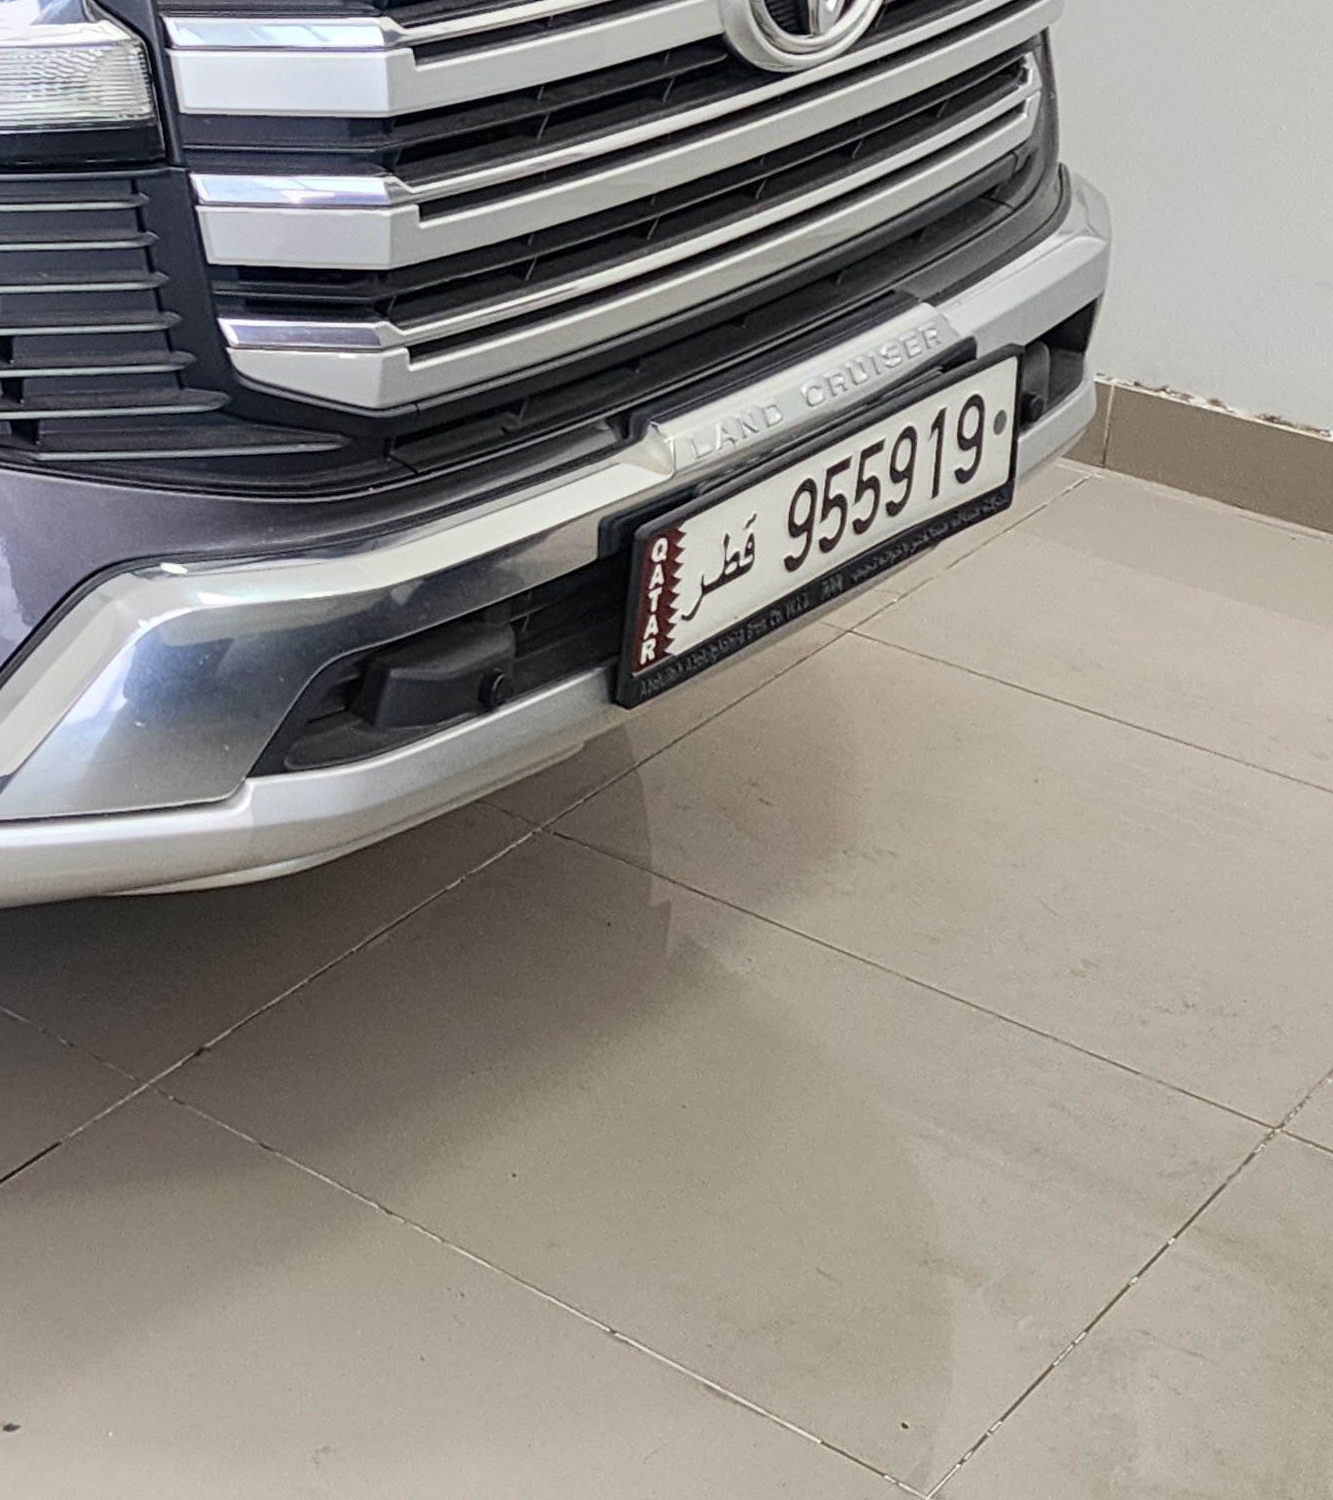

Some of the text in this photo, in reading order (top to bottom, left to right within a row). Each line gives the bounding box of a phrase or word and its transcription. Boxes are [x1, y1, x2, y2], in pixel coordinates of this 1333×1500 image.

[688, 323, 943, 460] LAND CRUISER
[784, 393, 987, 573] 955919
[640, 537, 669, 666] QATAR
[681, 511, 758, 622] قطر
